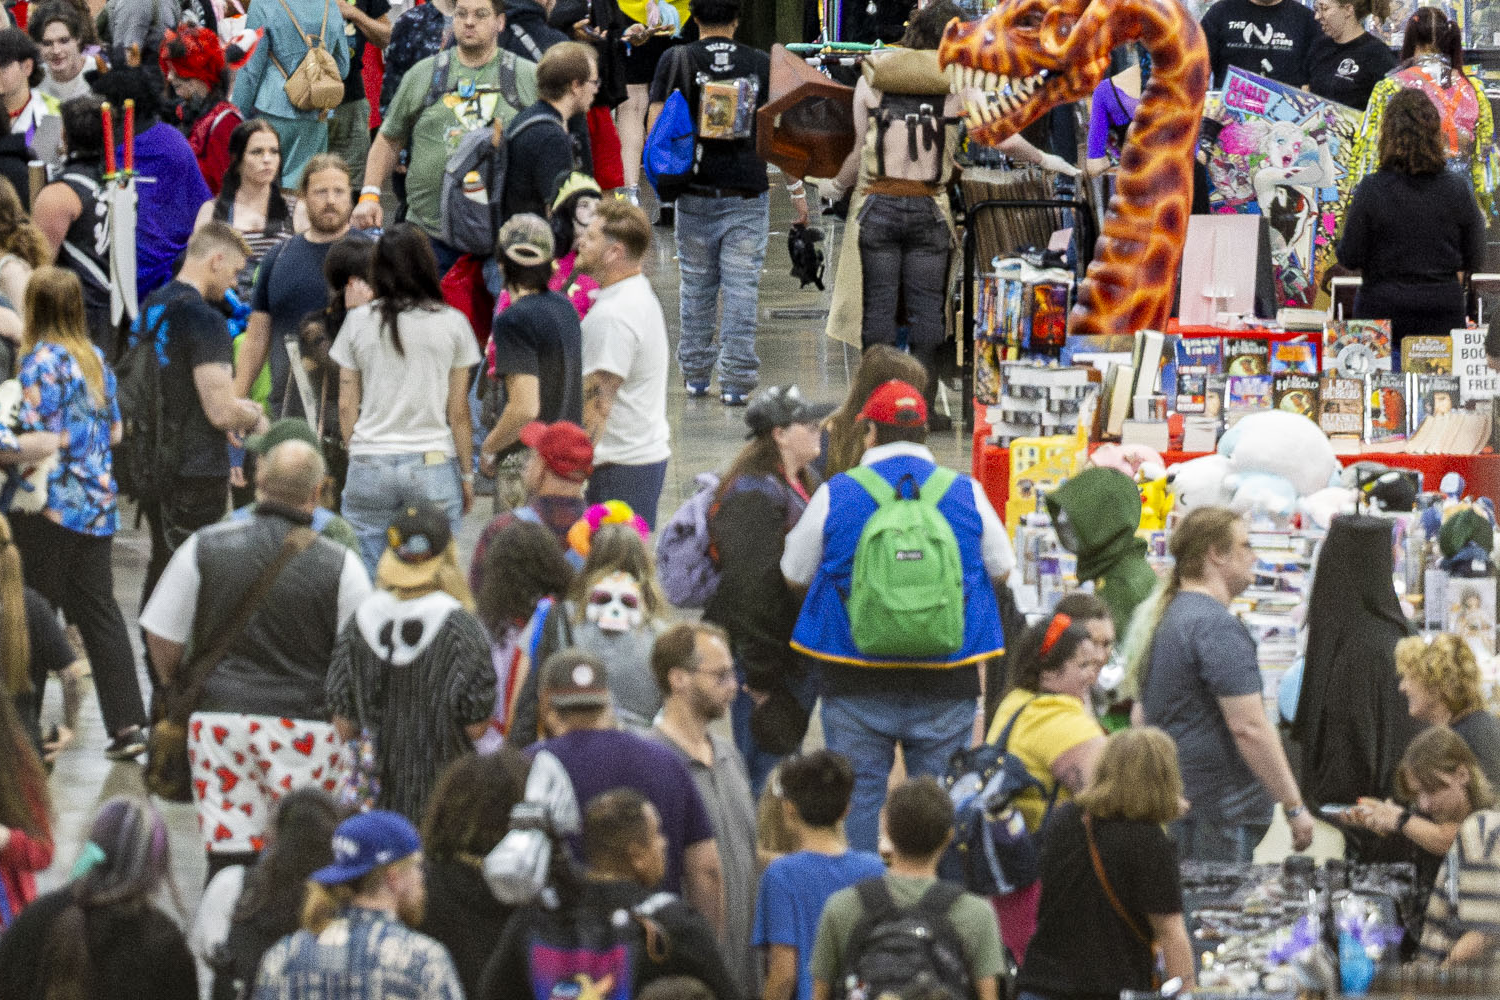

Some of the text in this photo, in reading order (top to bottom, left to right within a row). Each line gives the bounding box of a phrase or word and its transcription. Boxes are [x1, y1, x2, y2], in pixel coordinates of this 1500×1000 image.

[1228, 21, 1246, 29] THE
[1229, 75, 1270, 103] HARLEY
[1468, 380, 1497, 390] FREE
